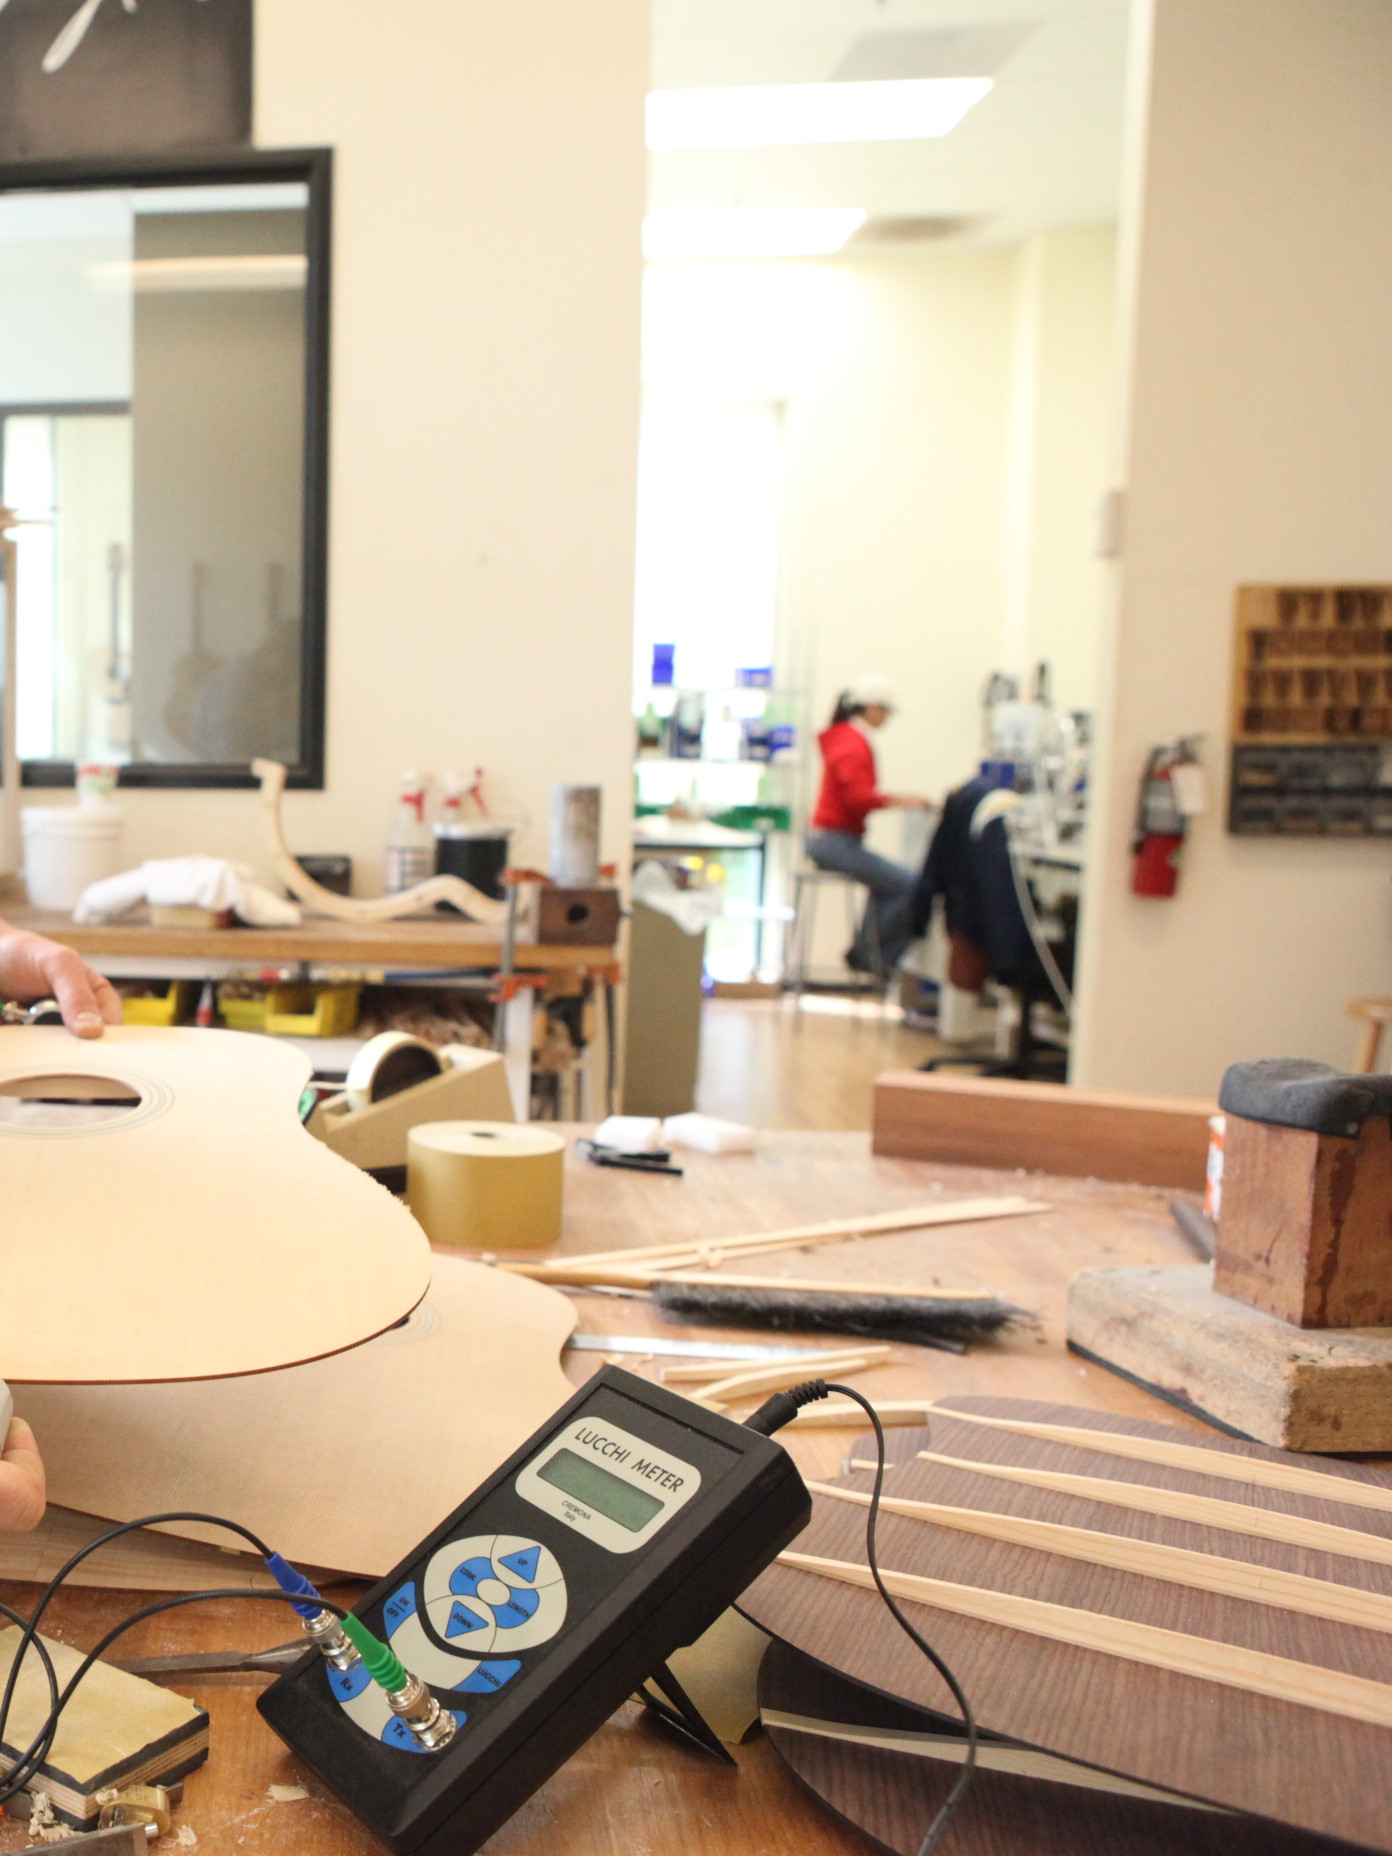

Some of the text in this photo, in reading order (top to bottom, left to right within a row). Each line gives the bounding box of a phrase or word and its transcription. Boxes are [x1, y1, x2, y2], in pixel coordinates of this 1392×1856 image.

[575, 1428, 684, 1492] LUCCHI METER
[561, 1500, 592, 1521] CREMONA
[563, 1511, 577, 1522] Italy
[517, 1557, 529, 1567] UP
[399, 1596, 410, 1607] ON
[507, 1601, 531, 1618] LENGTH
[386, 1607, 400, 1618] OFF
[452, 1612, 474, 1629] DOWN
[340, 1677, 354, 1692] Rx
[476, 1666, 502, 1688] LUCCHI
[393, 1722, 406, 1738] Tx
